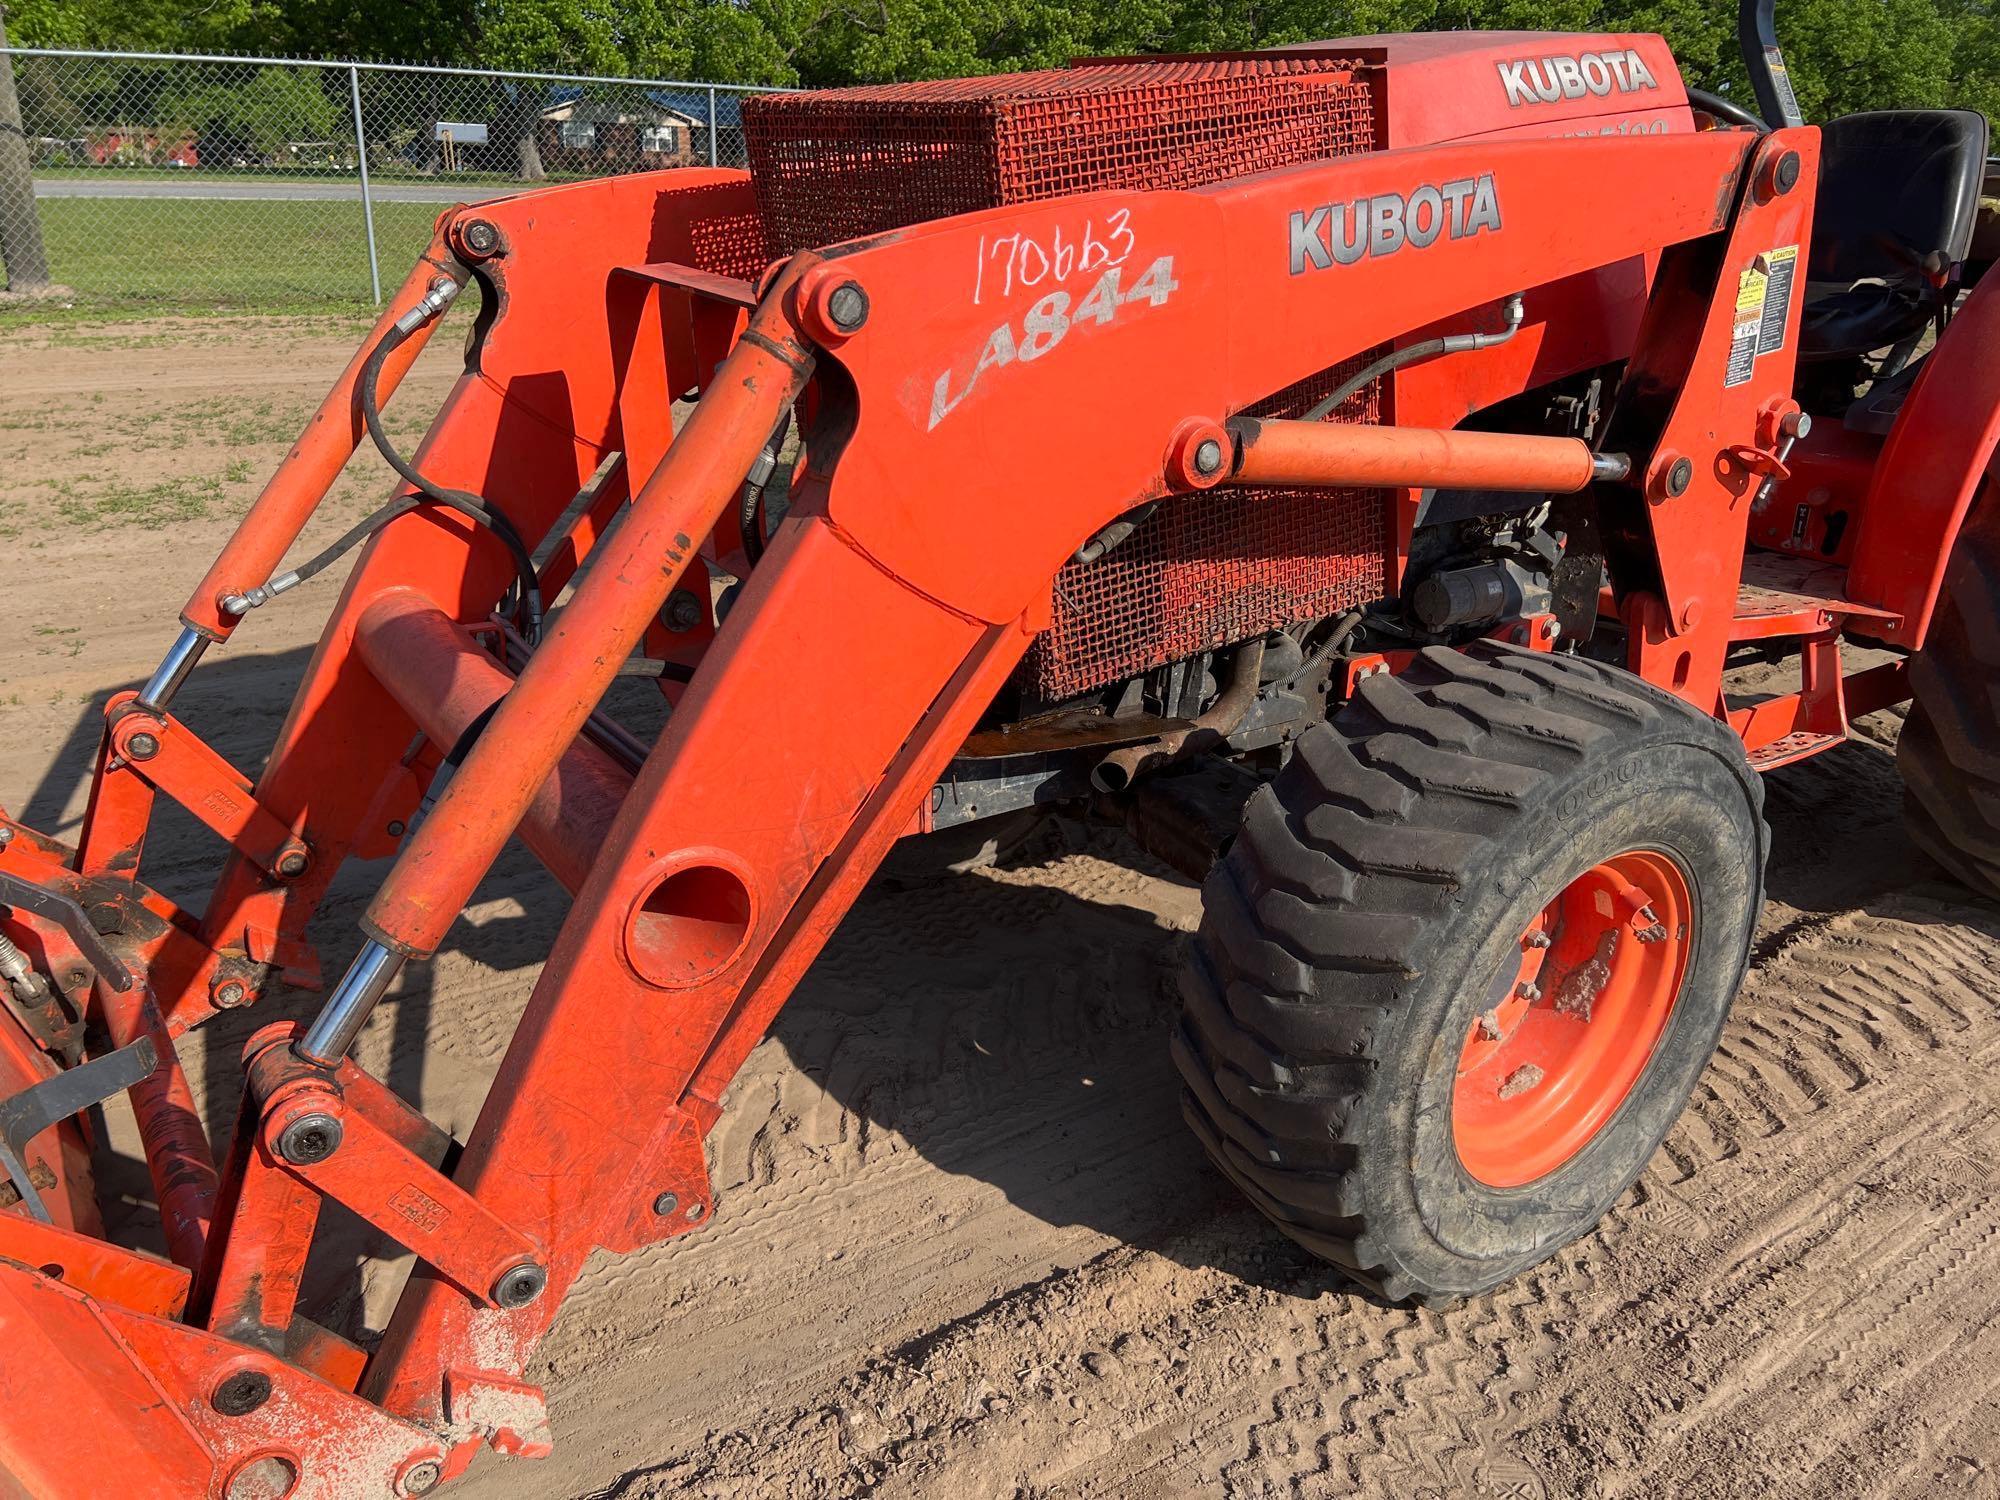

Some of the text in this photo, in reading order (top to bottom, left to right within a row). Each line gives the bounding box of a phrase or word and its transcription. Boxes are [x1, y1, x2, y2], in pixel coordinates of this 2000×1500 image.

[1497, 49, 1658, 107] KUBOTA
[973, 208, 1135, 305] 170663
[1289, 174, 1502, 275] KUBOTA
[1776, 250, 1796, 259] CAUTION
[927, 255, 1179, 433] LA844
